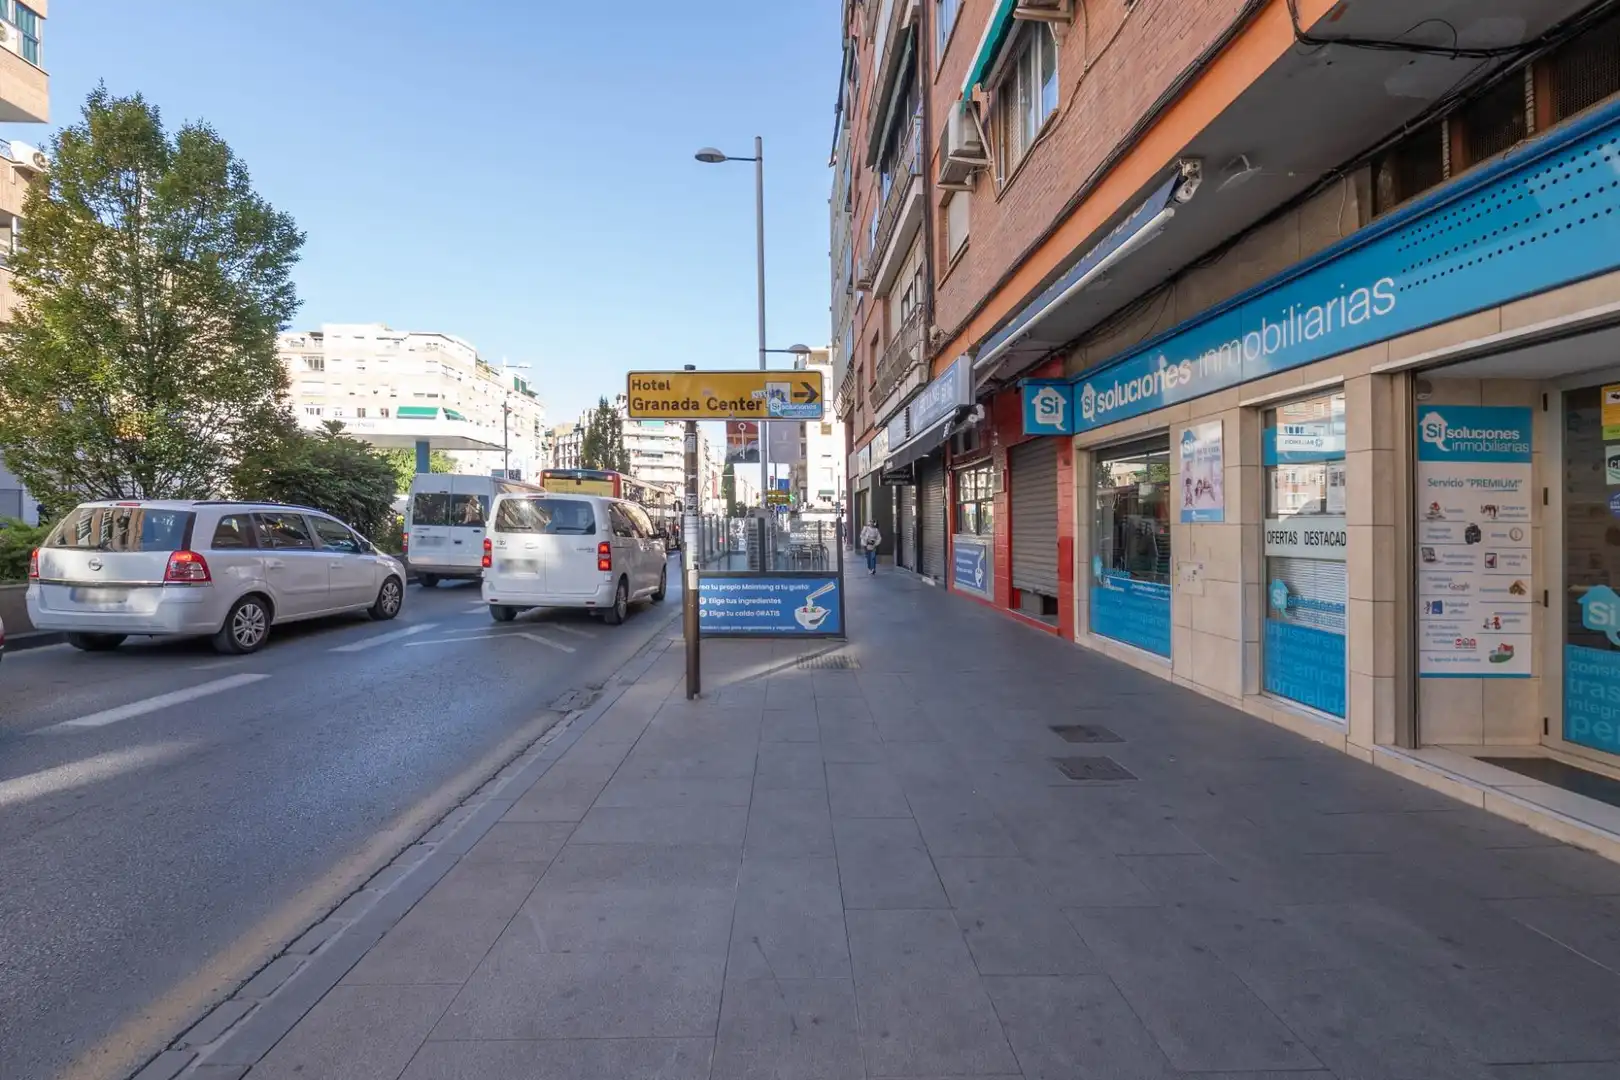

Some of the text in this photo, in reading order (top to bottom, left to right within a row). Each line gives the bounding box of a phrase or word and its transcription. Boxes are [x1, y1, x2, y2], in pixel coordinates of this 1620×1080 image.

[1083, 276, 1396, 414] Si soluciones inmobiliarias
[631, 379, 670, 391] Hotel
[632, 397, 763, 411] Granada Center
[1040, 396, 1060, 414] Si
[1426, 423, 1520, 440] Si soluciones
[1452, 440, 1529, 453] inmobiliarias
[1427, 477, 1464, 488] Servicio
[1266, 530, 1347, 547] OFERTAS DESTACAD
[708, 597, 725, 605] Elige
[738, 597, 782, 605] ingredientes
[709, 610, 725, 618] Elige
[1588, 601, 1617, 626] Si
